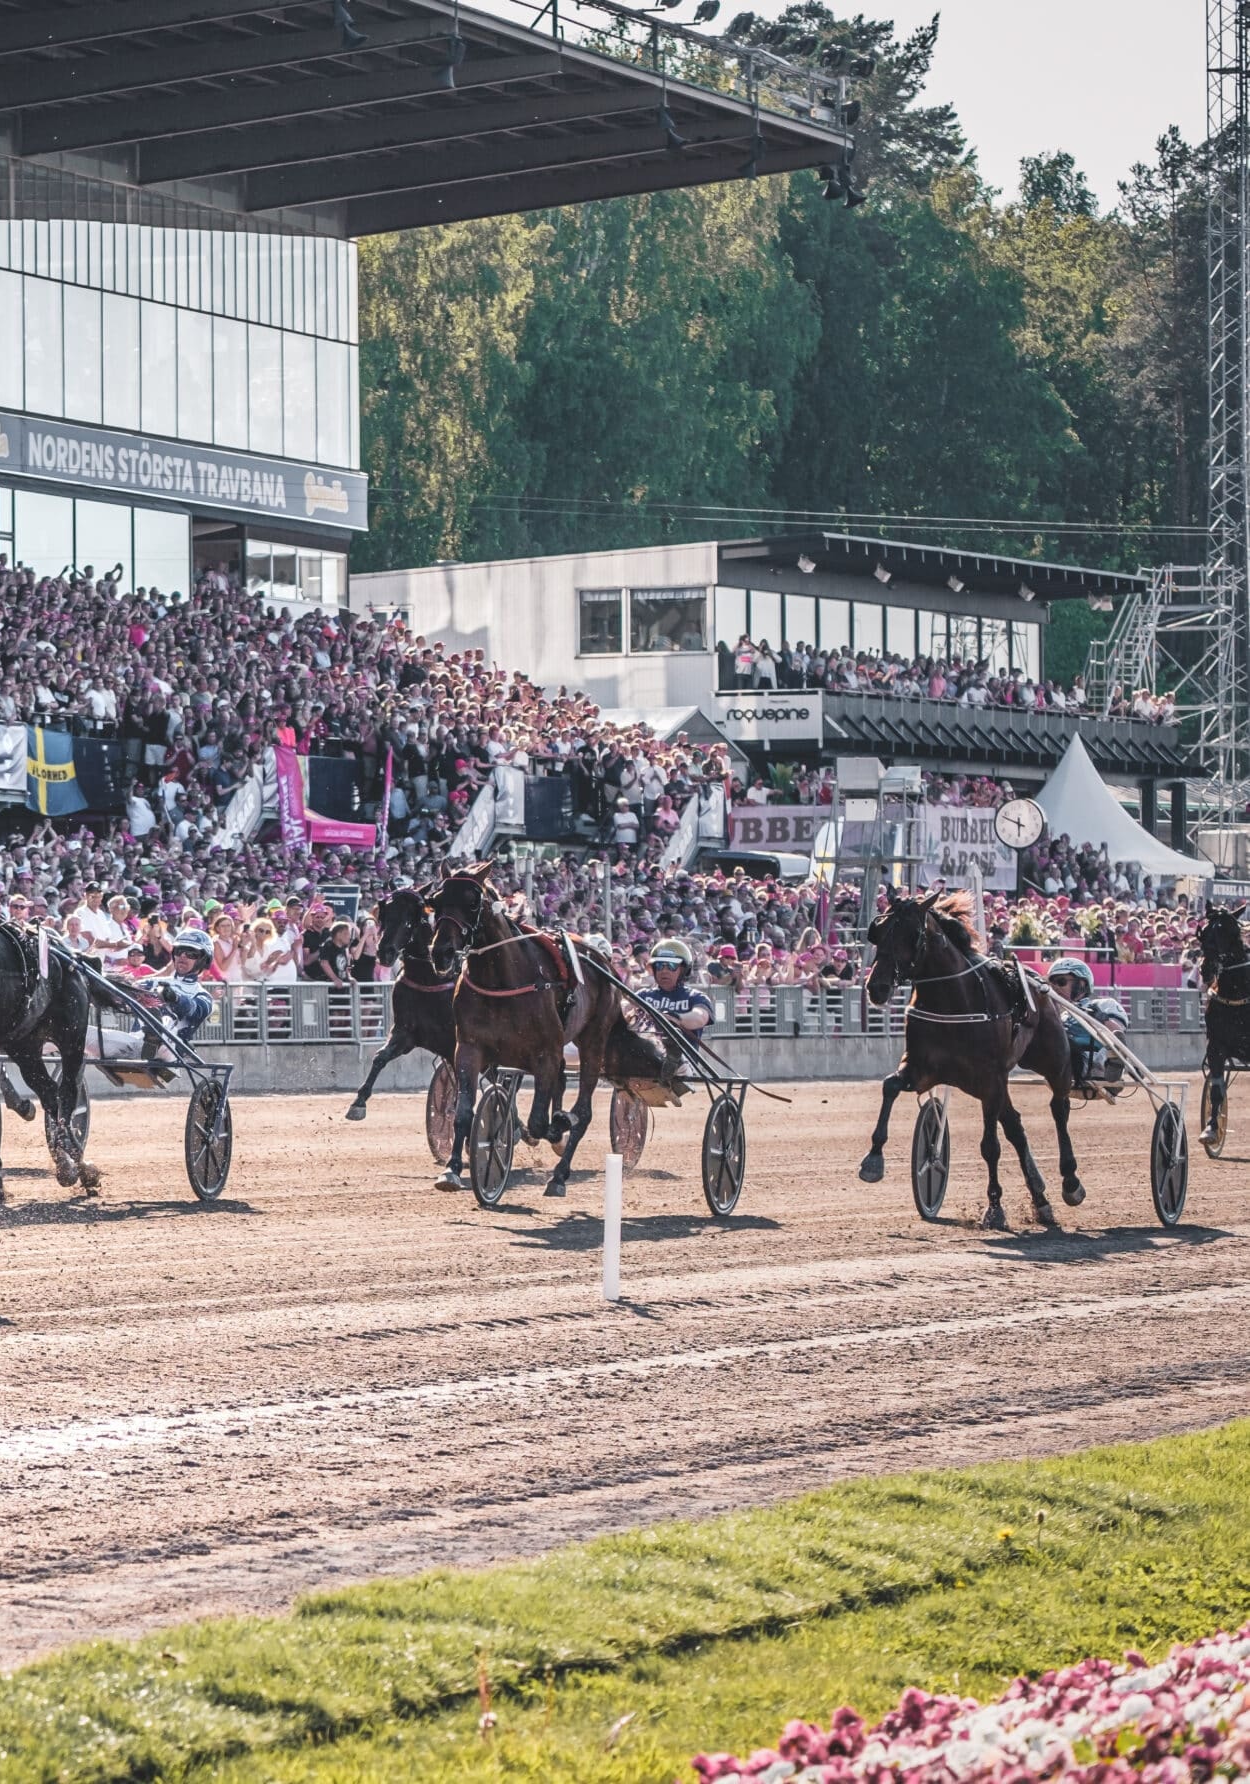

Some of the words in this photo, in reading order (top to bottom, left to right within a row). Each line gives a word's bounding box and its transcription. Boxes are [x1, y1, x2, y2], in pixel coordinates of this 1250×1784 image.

[28, 432, 115, 481] NORDENS
[118, 442, 194, 495] STÖRSTA
[197, 462, 286, 509] TRAVBANA
[727, 707, 809, 723] roquepine
[734, 816, 829, 844] BBE
[940, 815, 996, 844] BUBBEL
